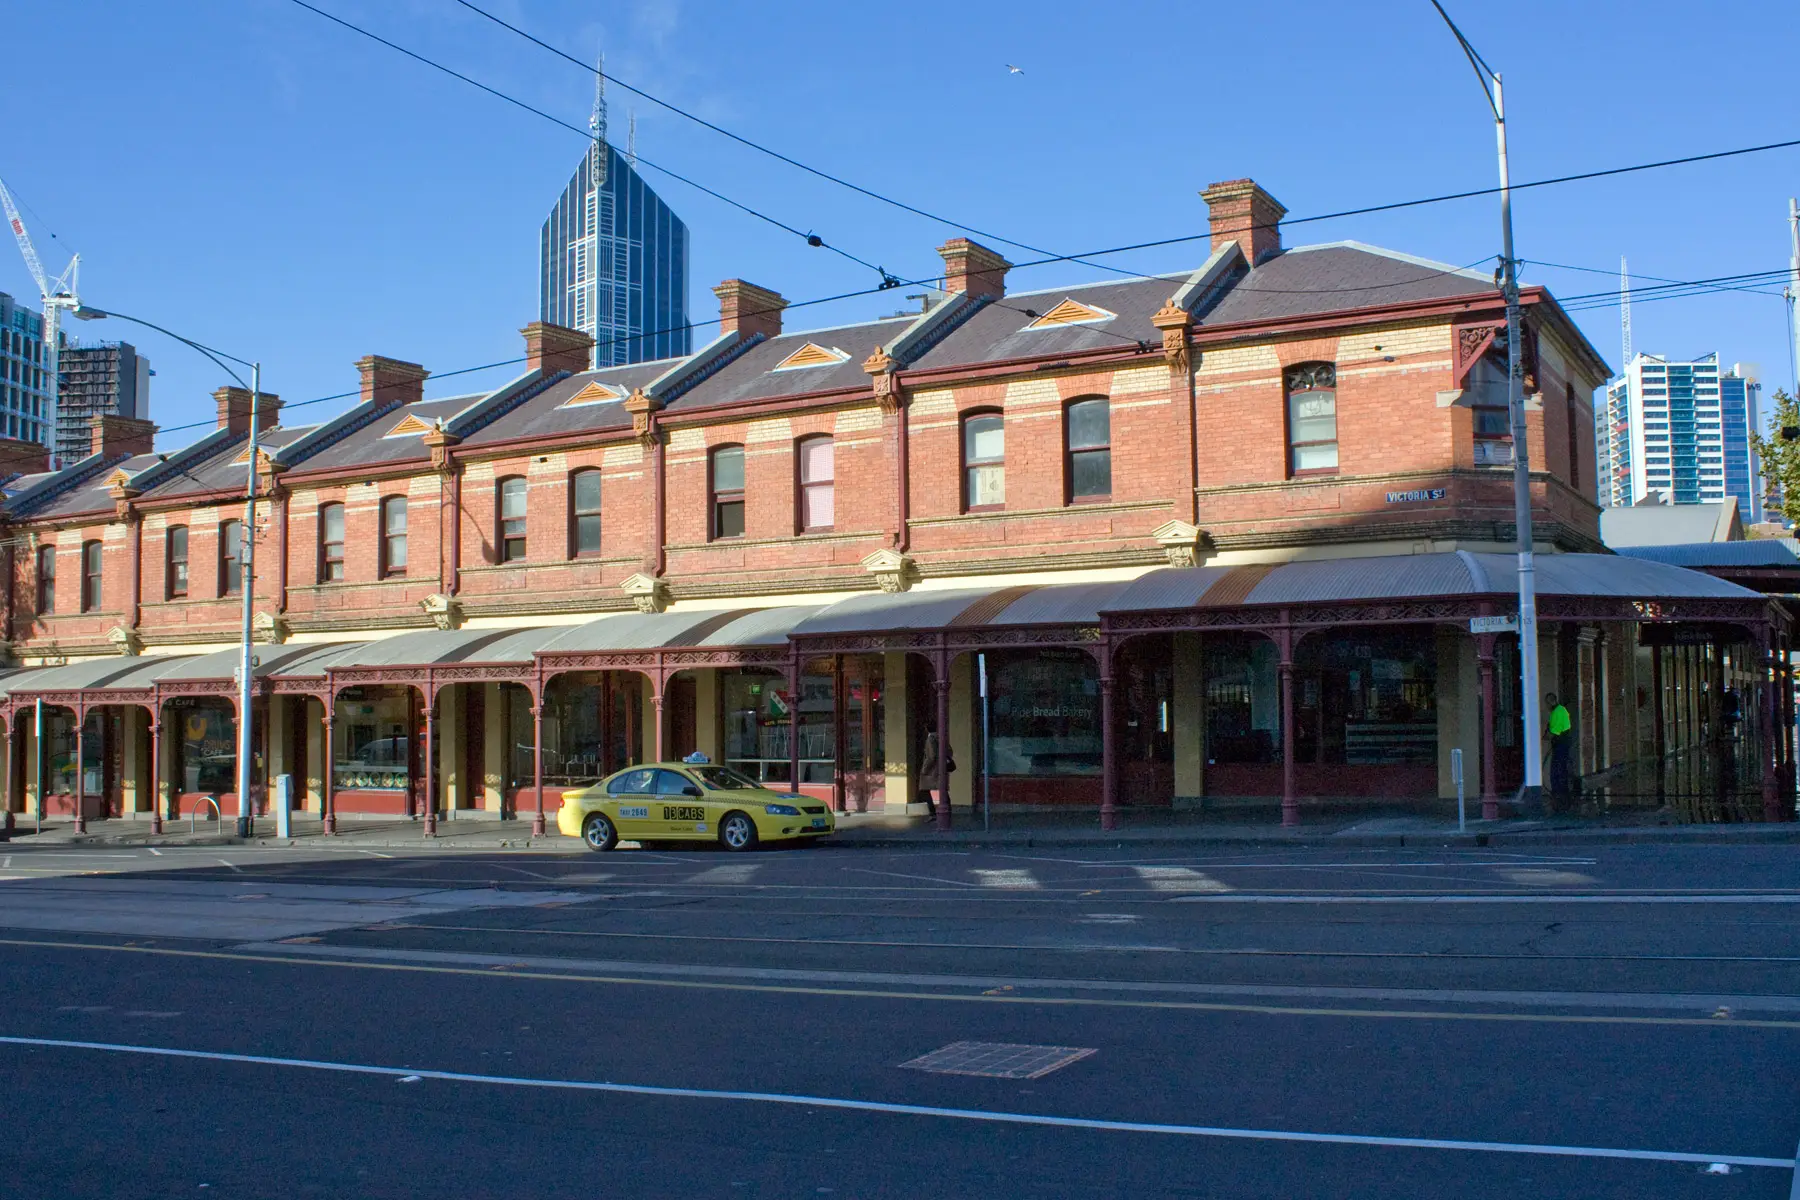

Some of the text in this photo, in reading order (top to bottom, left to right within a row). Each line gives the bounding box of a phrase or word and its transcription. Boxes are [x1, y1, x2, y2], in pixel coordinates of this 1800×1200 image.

[1388, 490, 1429, 501] VICTORIA
[1472, 616, 1502, 627] VICTORIA
[1033, 705, 1060, 717] Bread
[1062, 705, 1092, 720] Bakery
